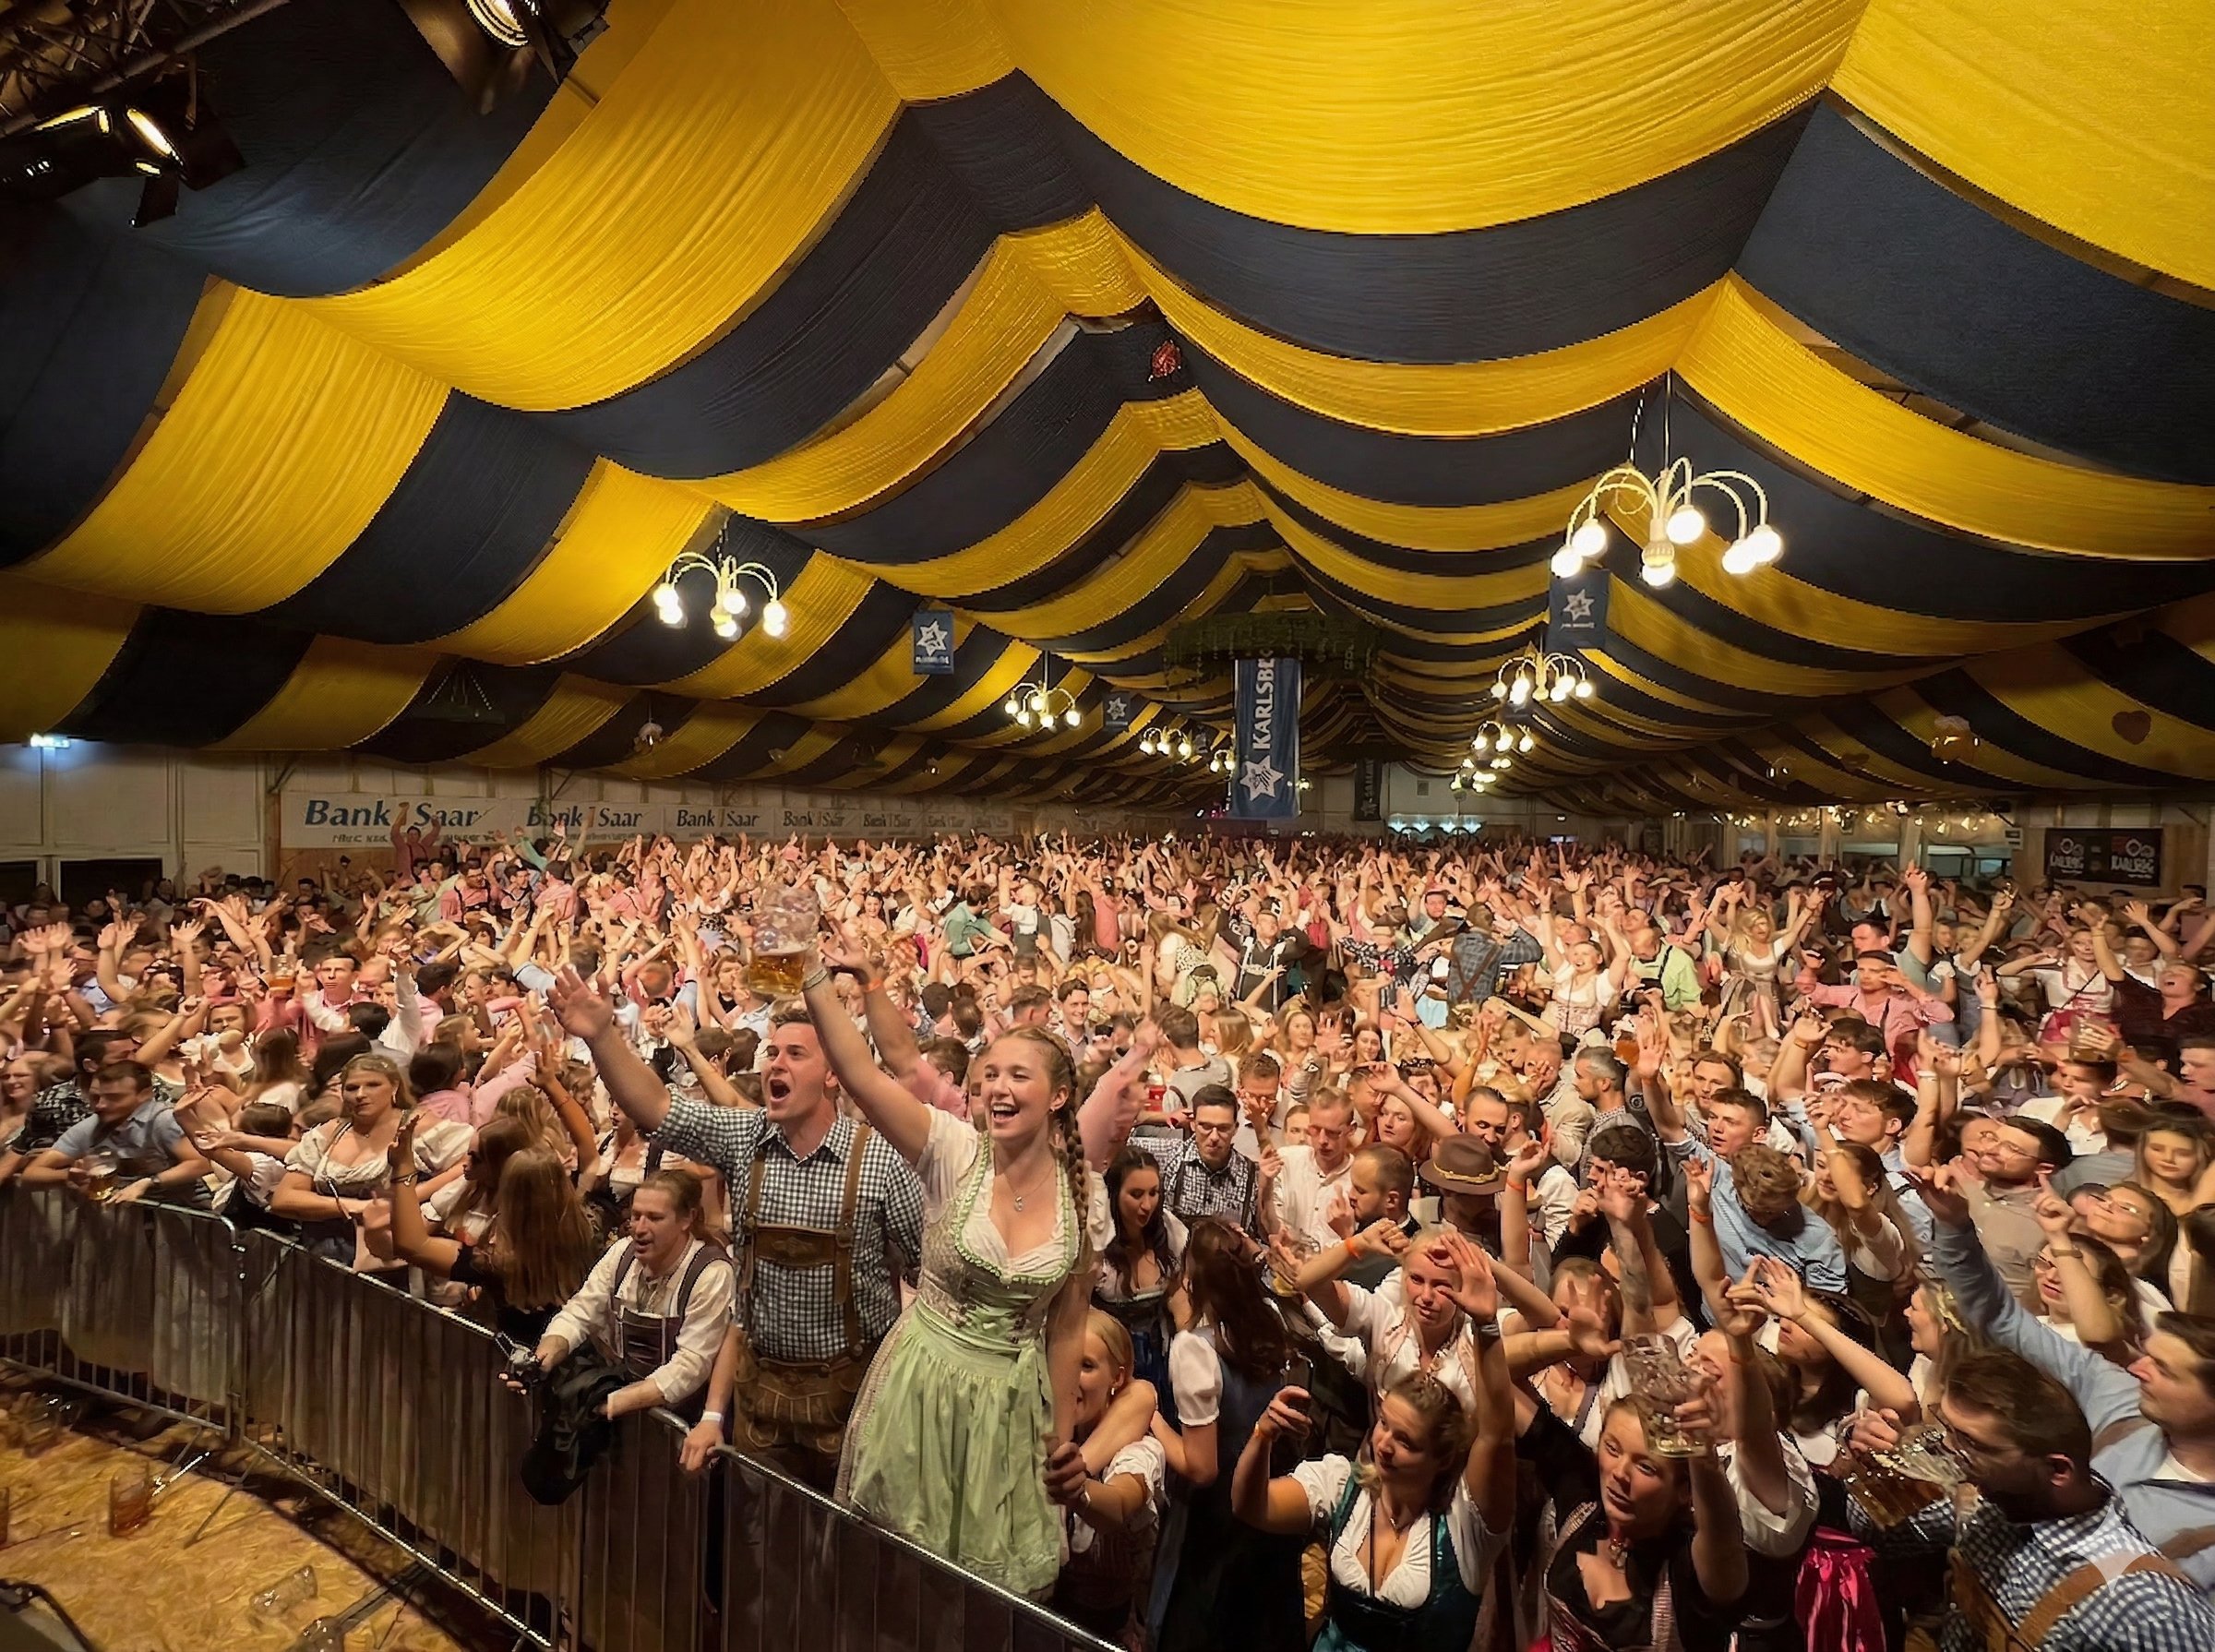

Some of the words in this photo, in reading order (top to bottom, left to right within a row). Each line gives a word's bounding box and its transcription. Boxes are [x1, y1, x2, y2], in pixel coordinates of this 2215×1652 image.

[305, 799, 391, 827] Bank
[413, 801, 479, 828] Saar
[598, 807, 643, 828] Saar
[676, 808, 715, 828] Bank
[726, 810, 760, 828] Saar
